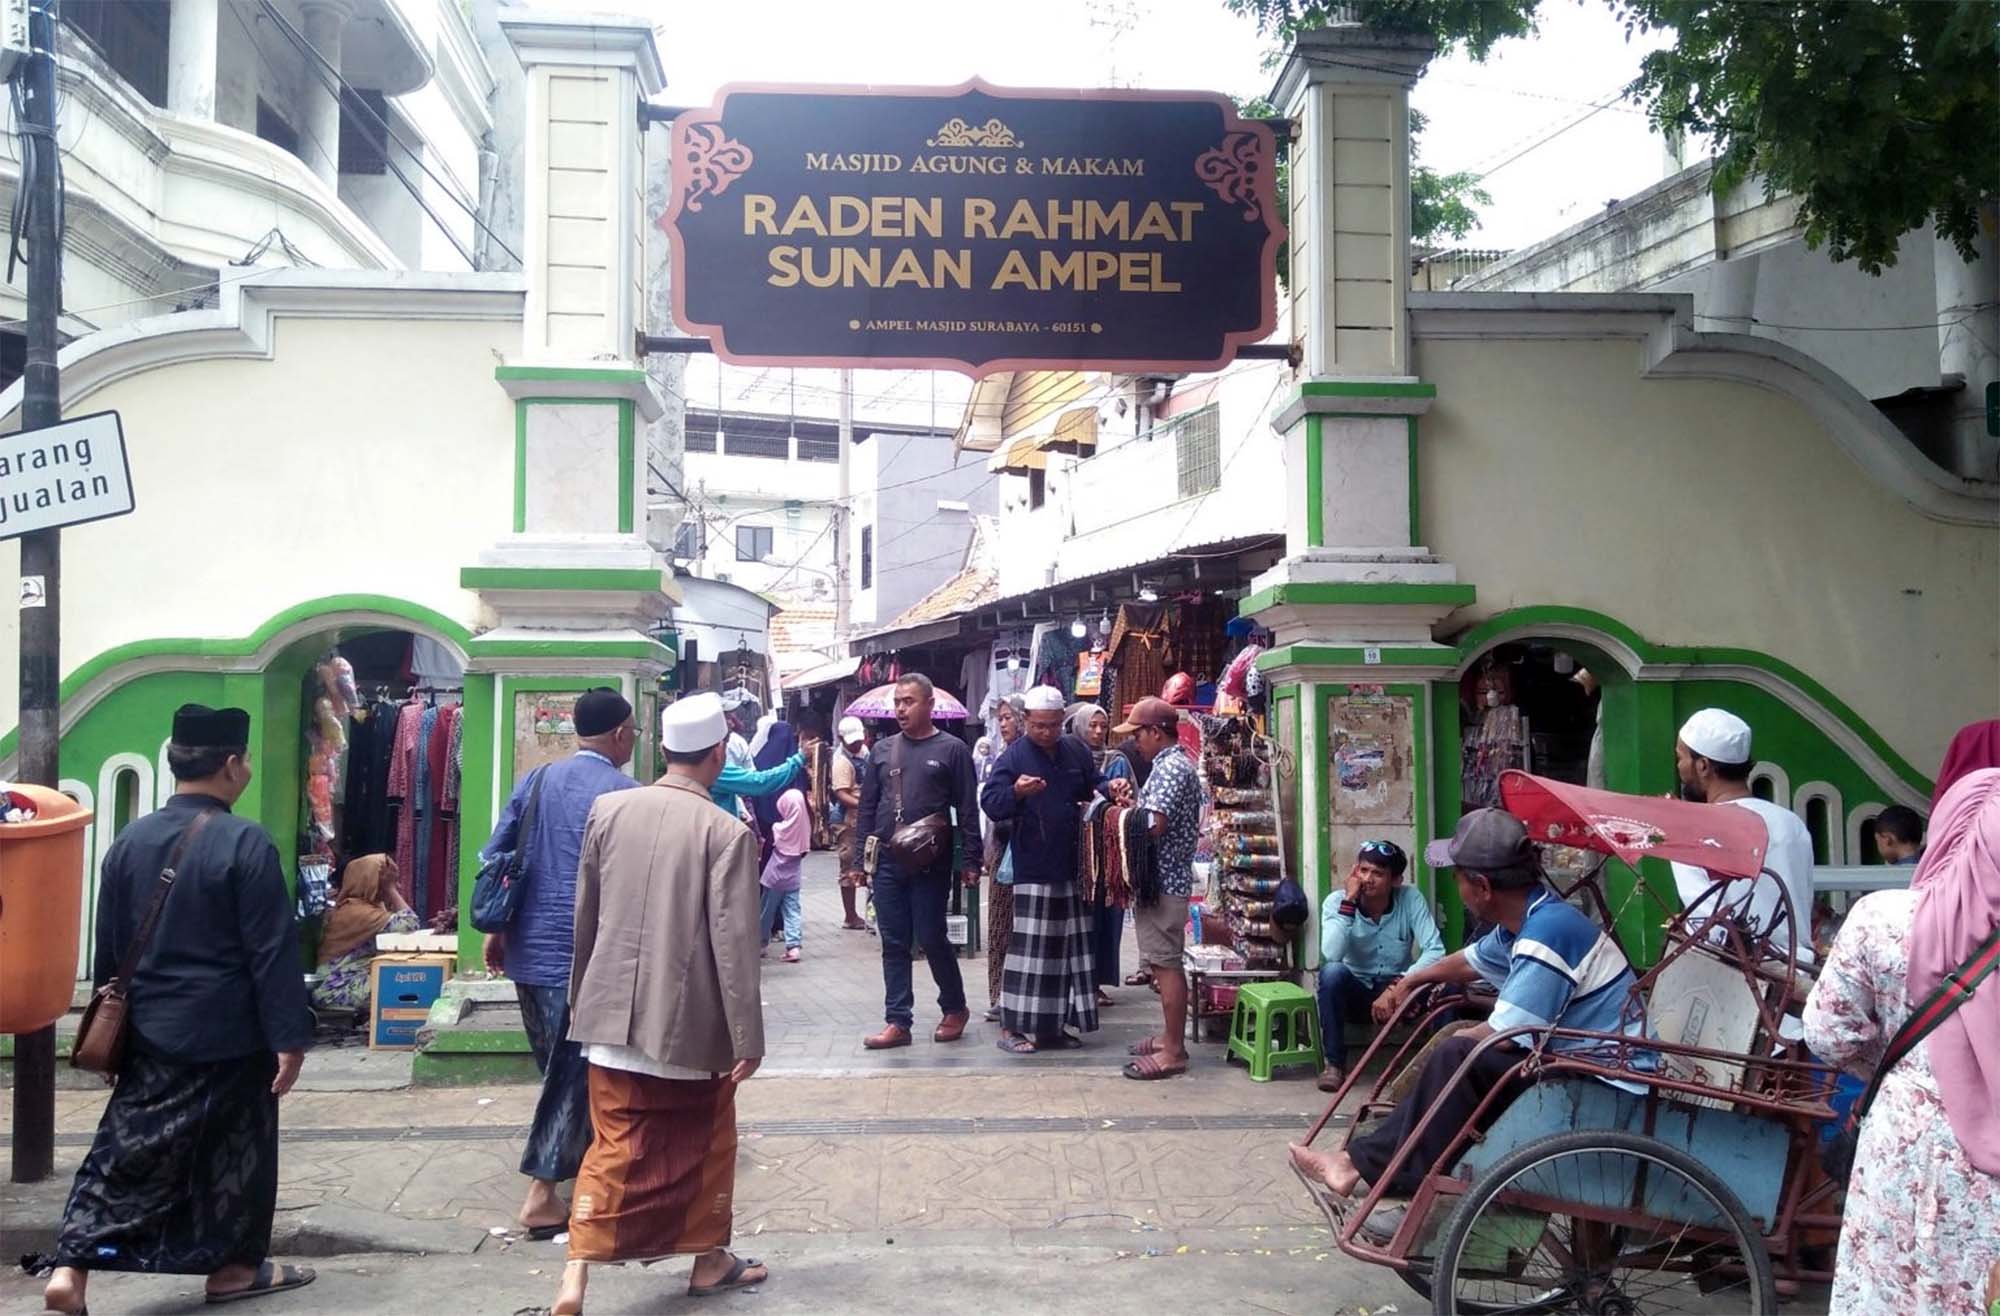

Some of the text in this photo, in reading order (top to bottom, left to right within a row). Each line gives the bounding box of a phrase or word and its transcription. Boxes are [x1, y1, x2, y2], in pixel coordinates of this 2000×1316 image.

[805, 152, 1145, 176] MASJID AGUNG & MAKAM
[744, 194, 1203, 241] RADEN RAHMAT
[768, 246, 1181, 292] SUNAN AMPEL
[865, 319, 913, 331] AMPEL
[915, 320, 966, 333] MASJID
[969, 321, 1040, 333] SURABAYA
[1052, 322, 1087, 333] 60151
